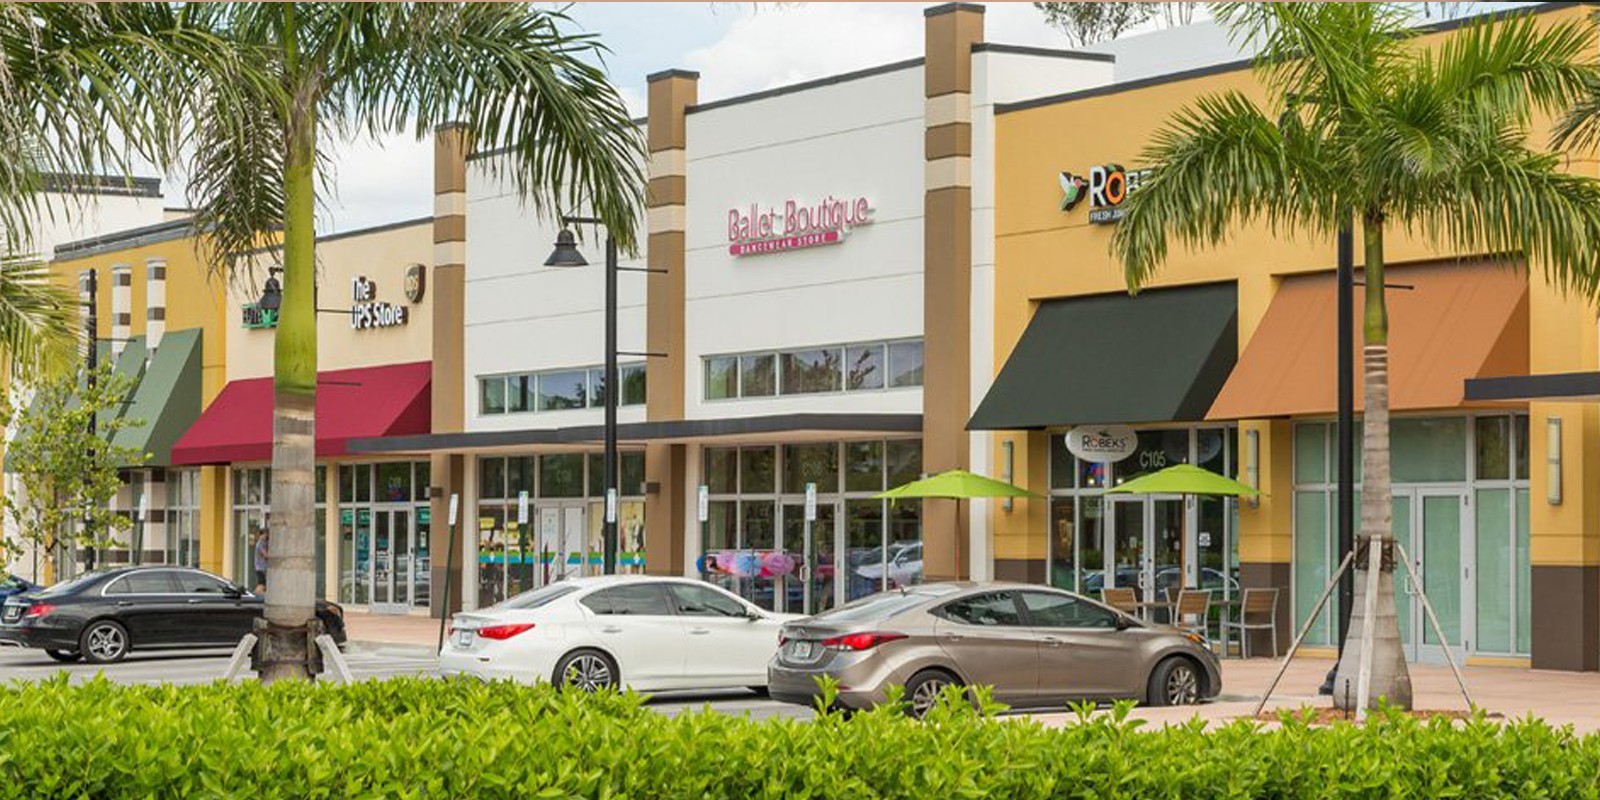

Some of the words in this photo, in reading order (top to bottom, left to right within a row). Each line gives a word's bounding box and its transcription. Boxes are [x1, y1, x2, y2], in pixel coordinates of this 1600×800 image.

[728, 202, 777, 241] Ballet
[784, 195, 870, 234] Boutique
[739, 240, 793, 254] DANCEWEAR
[797, 233, 827, 247] STORE
[351, 275, 372, 300] The
[351, 303, 373, 329] UPS
[373, 302, 403, 327] Store
[1081, 435, 1126, 448] ROBEKS
[1139, 450, 1166, 468] C105
